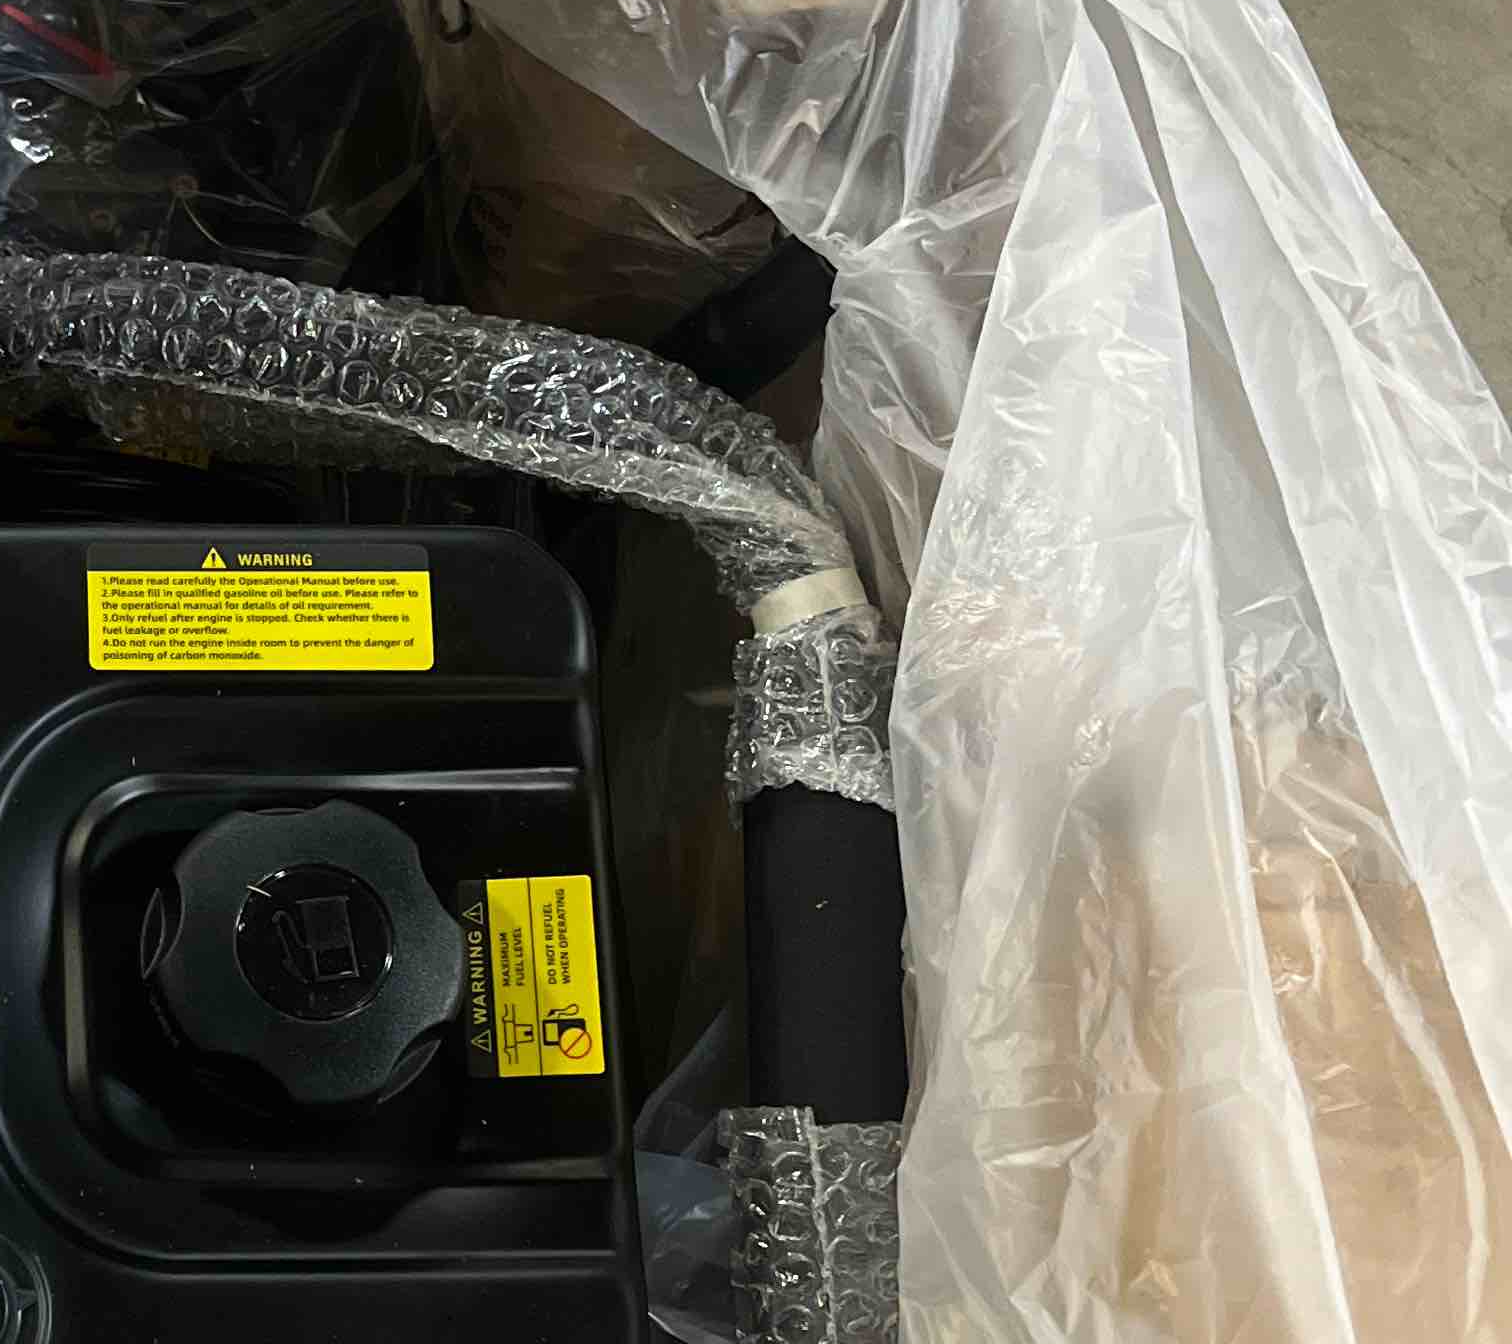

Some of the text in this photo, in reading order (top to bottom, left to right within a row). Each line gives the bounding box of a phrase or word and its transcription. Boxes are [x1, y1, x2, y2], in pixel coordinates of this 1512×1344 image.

[237, 552, 314, 568] WARNING
[146, 577, 170, 585] read
[172, 577, 217, 587] carefully
[219, 577, 235, 585] the
[238, 577, 299, 587] Operational
[301, 577, 340, 585] Manual
[343, 577, 376, 585] before
[102, 589, 145, 598] 2.Please
[148, 589, 160, 598] fill
[163, 589, 173, 598] in
[176, 589, 221, 599] qualified
[223, 589, 268, 599] gasoline
[270, 589, 283, 598] oil
[285, 589, 319, 598] before
[344, 589, 379, 598] Please
[381, 589, 406, 598] refer
[408, 589, 419, 598] to
[102, 601, 374, 611] the operational manual for details of oil requirement.
[103, 613, 410, 624] 3.Only refuel after engine is stopped. Check whether there is
[102, 626, 123, 634] fuel
[125, 626, 166, 636] leakage
[182, 626, 230, 634] overflow.
[103, 639, 127, 647] 4.Do
[129, 639, 147, 647] not
[169, 639, 185, 647] the
[188, 639, 223, 649] engine
[226, 639, 257, 647] inside
[289, 639, 300, 647] to
[302, 639, 343, 649] prevent
[344, 639, 361, 647] the
[363, 639, 401, 649] danger
[403, 639, 415, 647] of
[156, 651, 168, 660] of
[170, 651, 206, 660] carbon
[555, 888, 571, 985] WHEN OPERATING
[542, 903, 557, 985] DO NOT REFUEL
[499, 931, 511, 987] MAXIMUM
[512, 927, 525, 987] FUEL LEVEL
[467, 929, 489, 1025] WARNING
